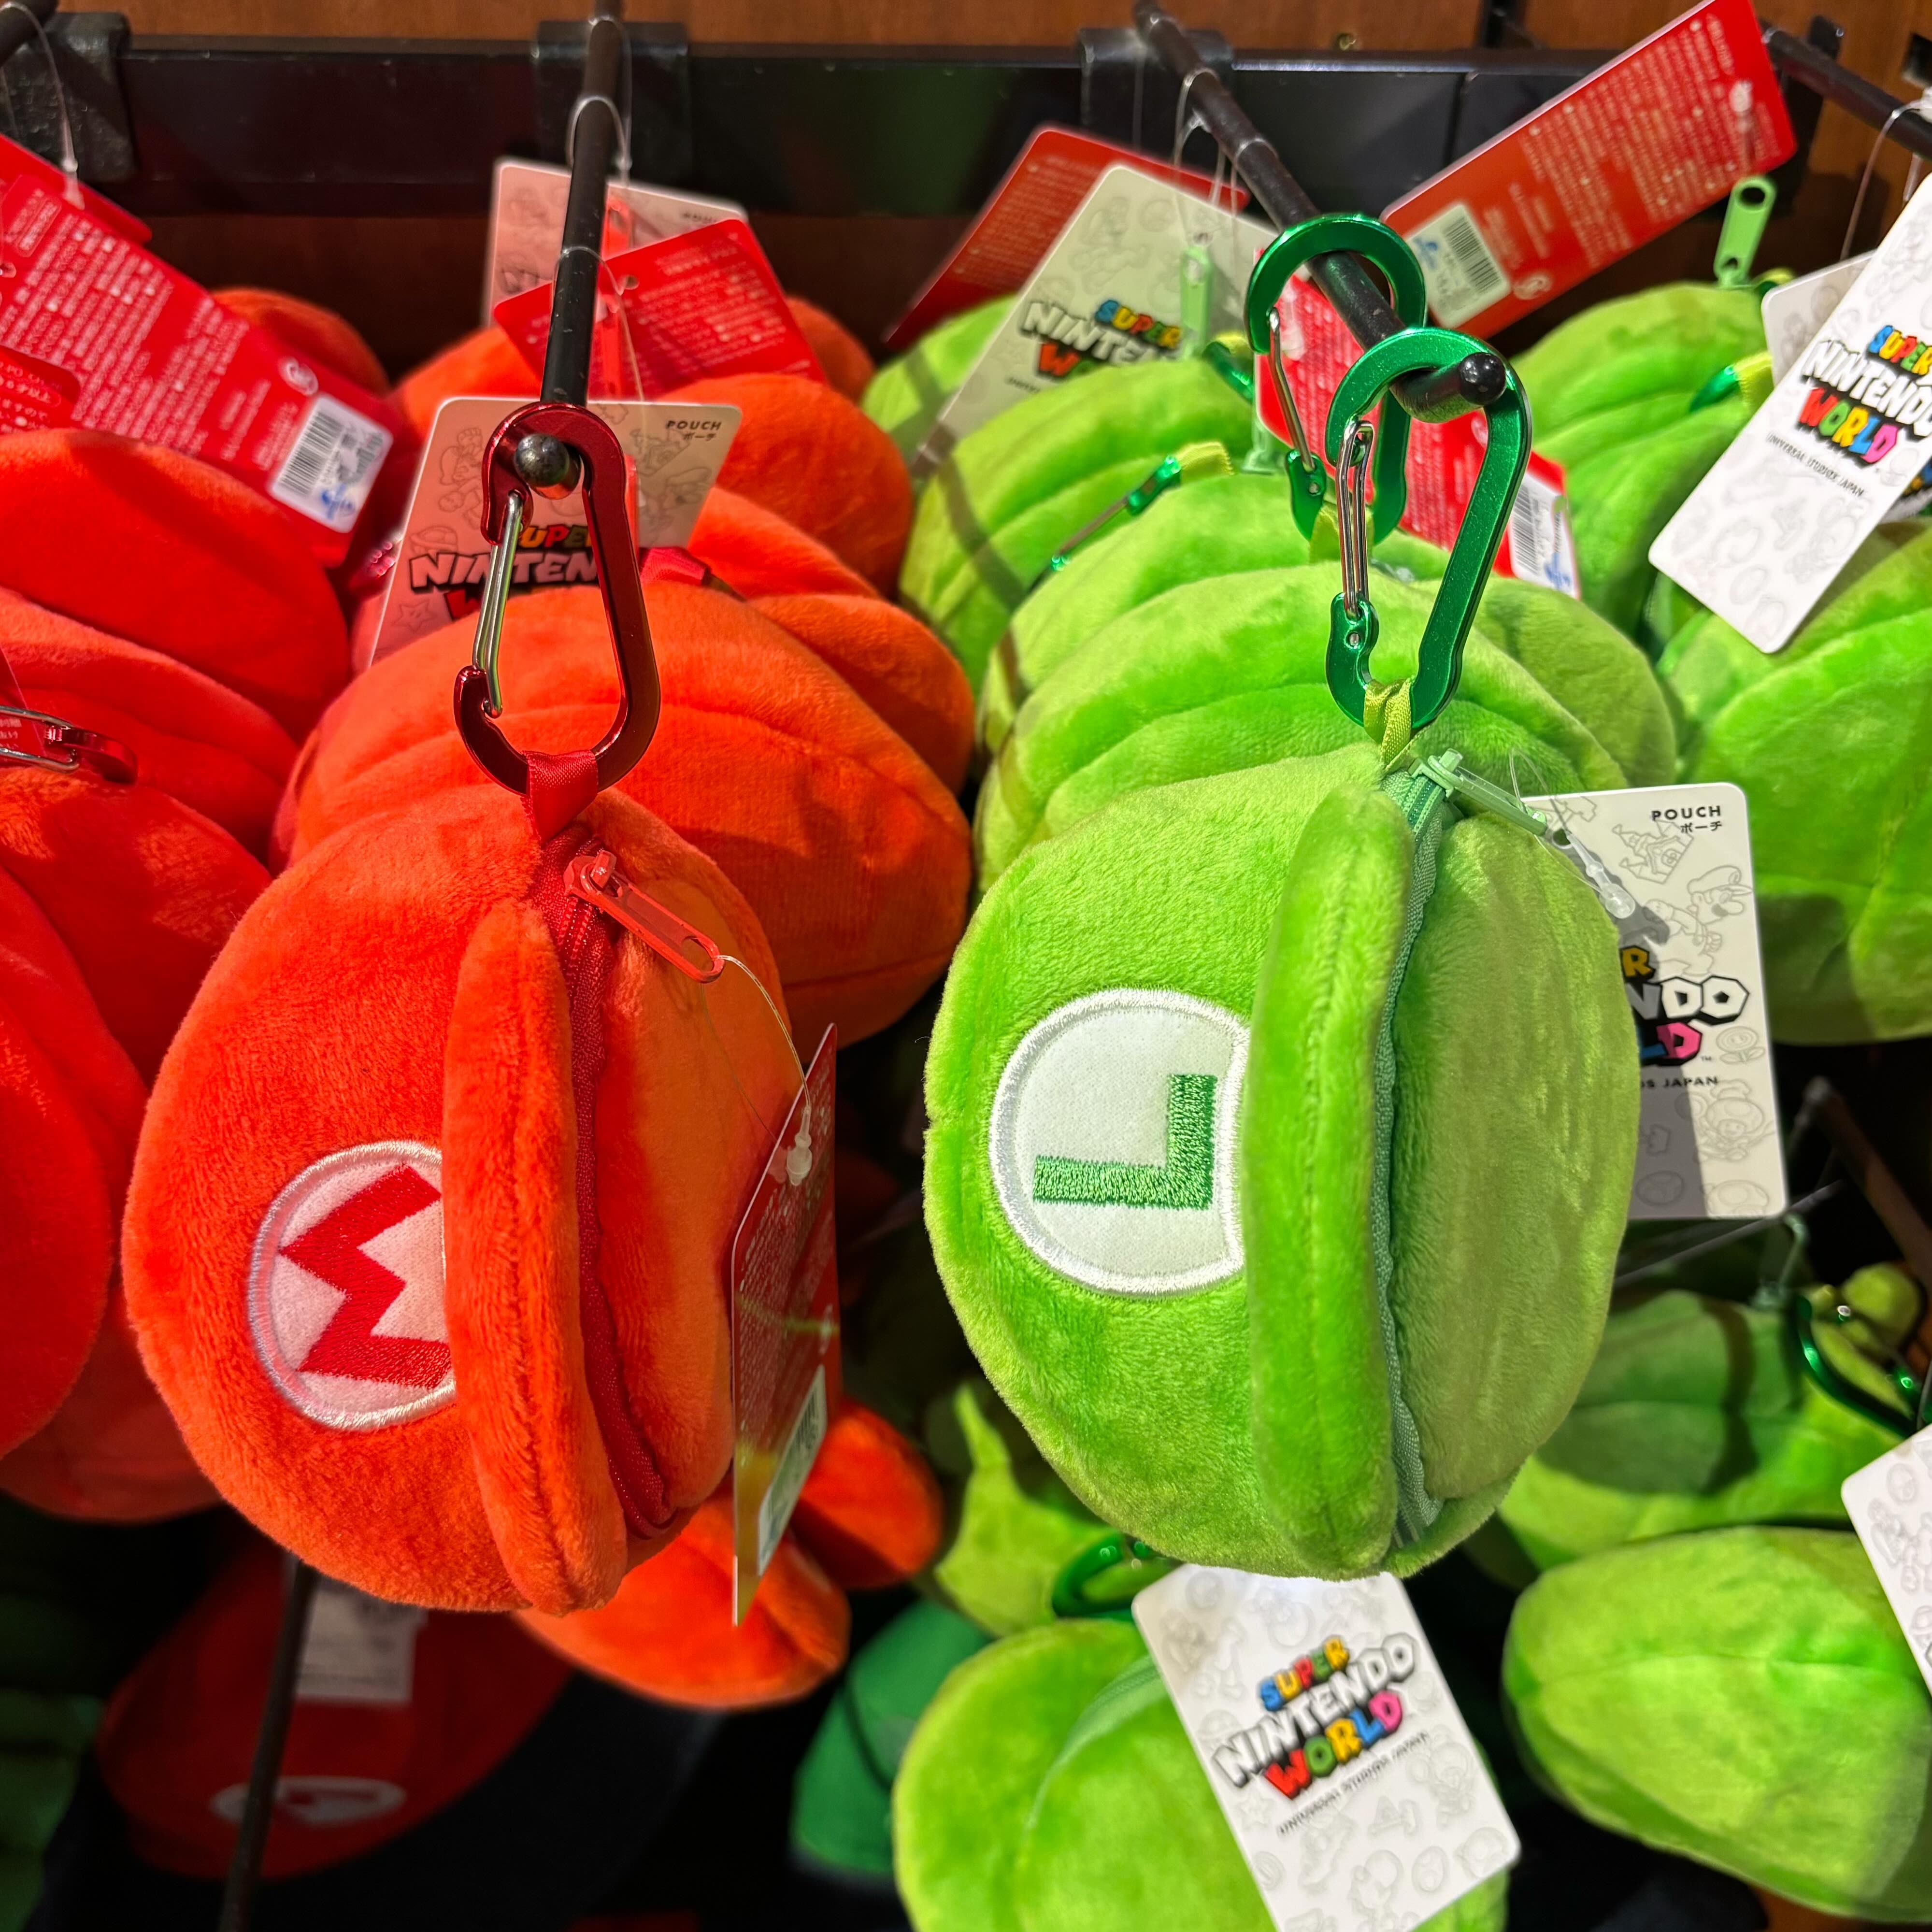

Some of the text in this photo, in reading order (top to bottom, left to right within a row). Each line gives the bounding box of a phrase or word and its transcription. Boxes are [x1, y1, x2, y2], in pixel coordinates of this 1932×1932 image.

[1094, 300, 1181, 349] SUPER
[1868, 325, 1932, 376] SUPER
[667, 420, 722, 430] POUCH
[1797, 386, 1900, 464] WORLD
[1839, 477, 1864, 497] JAPAN
[1651, 806, 1721, 820] POUCH
[1680, 821, 1722, 833] ポーチ
[1664, 1076, 1718, 1087] JAPAN
[1032, 1073, 1218, 1210] L
[278, 1162, 451, 1389] M
[1259, 1636, 1350, 1712] SUPER
[1212, 1633, 1417, 1788] NINTENDO
[1264, 1691, 1402, 1801] WORLD
